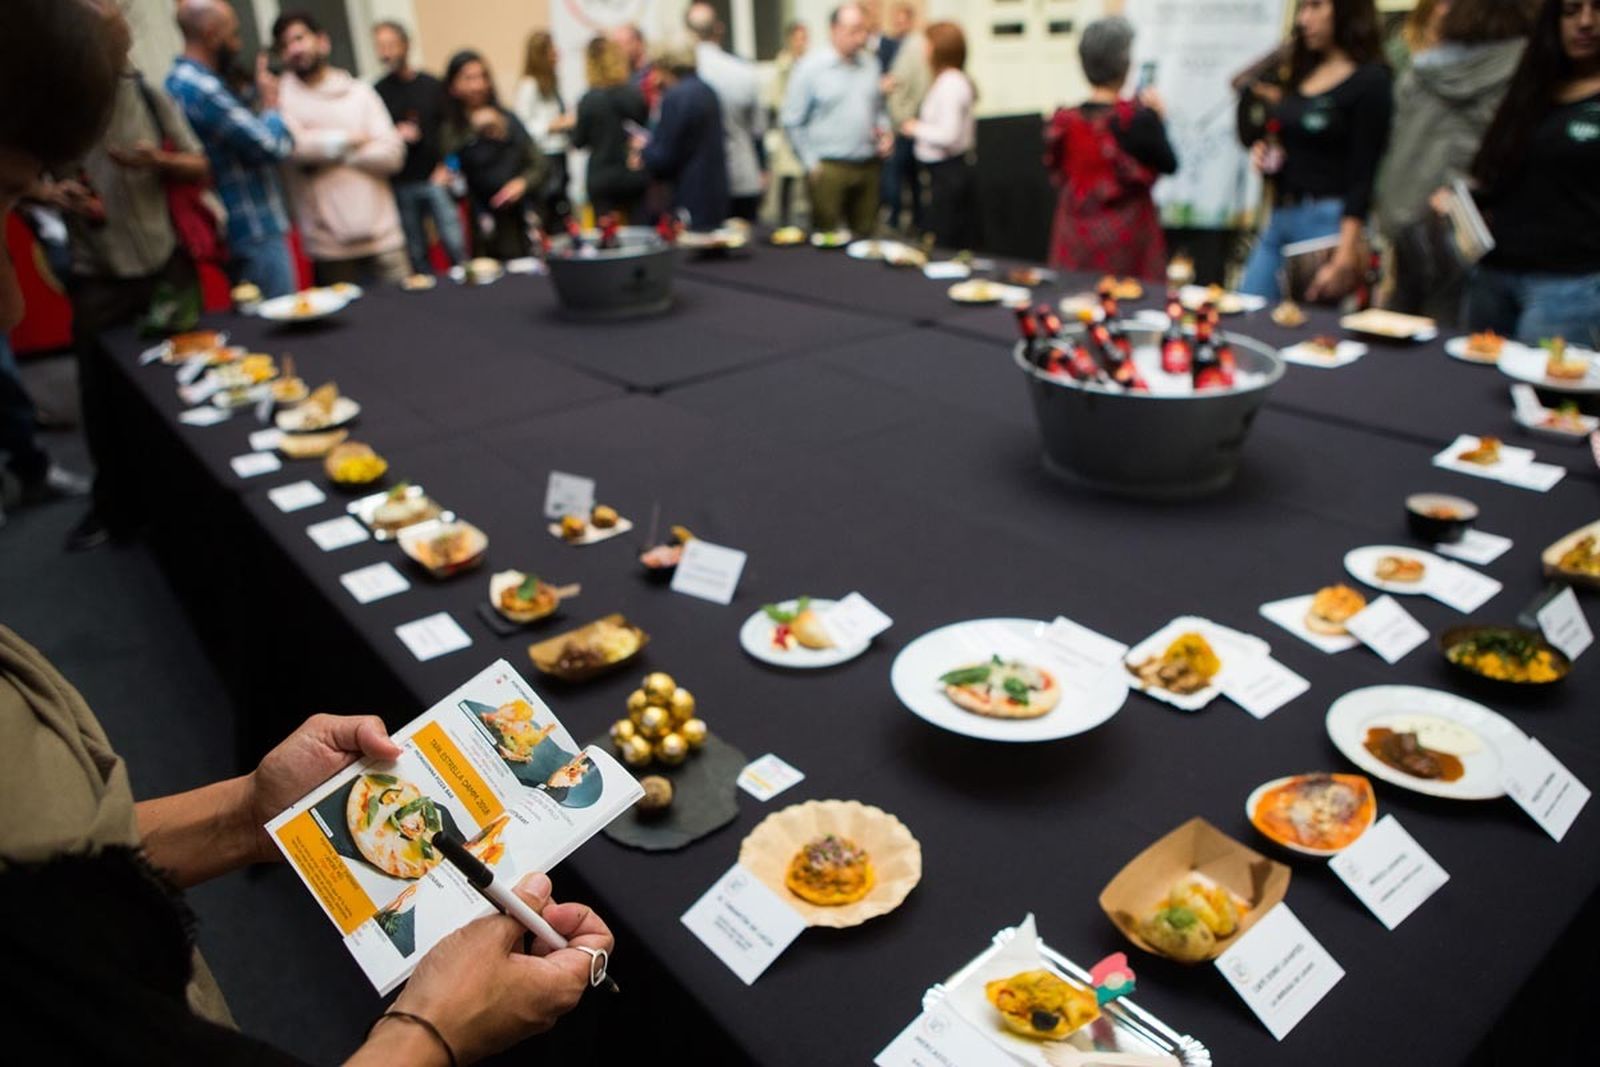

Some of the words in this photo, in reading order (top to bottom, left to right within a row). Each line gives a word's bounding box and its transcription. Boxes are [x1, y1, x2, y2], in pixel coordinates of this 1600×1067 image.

[435, 776, 447, 790] PIZZA
[440, 752, 464, 781] ESTRELLA
[461, 779, 479, 800] DAMM
